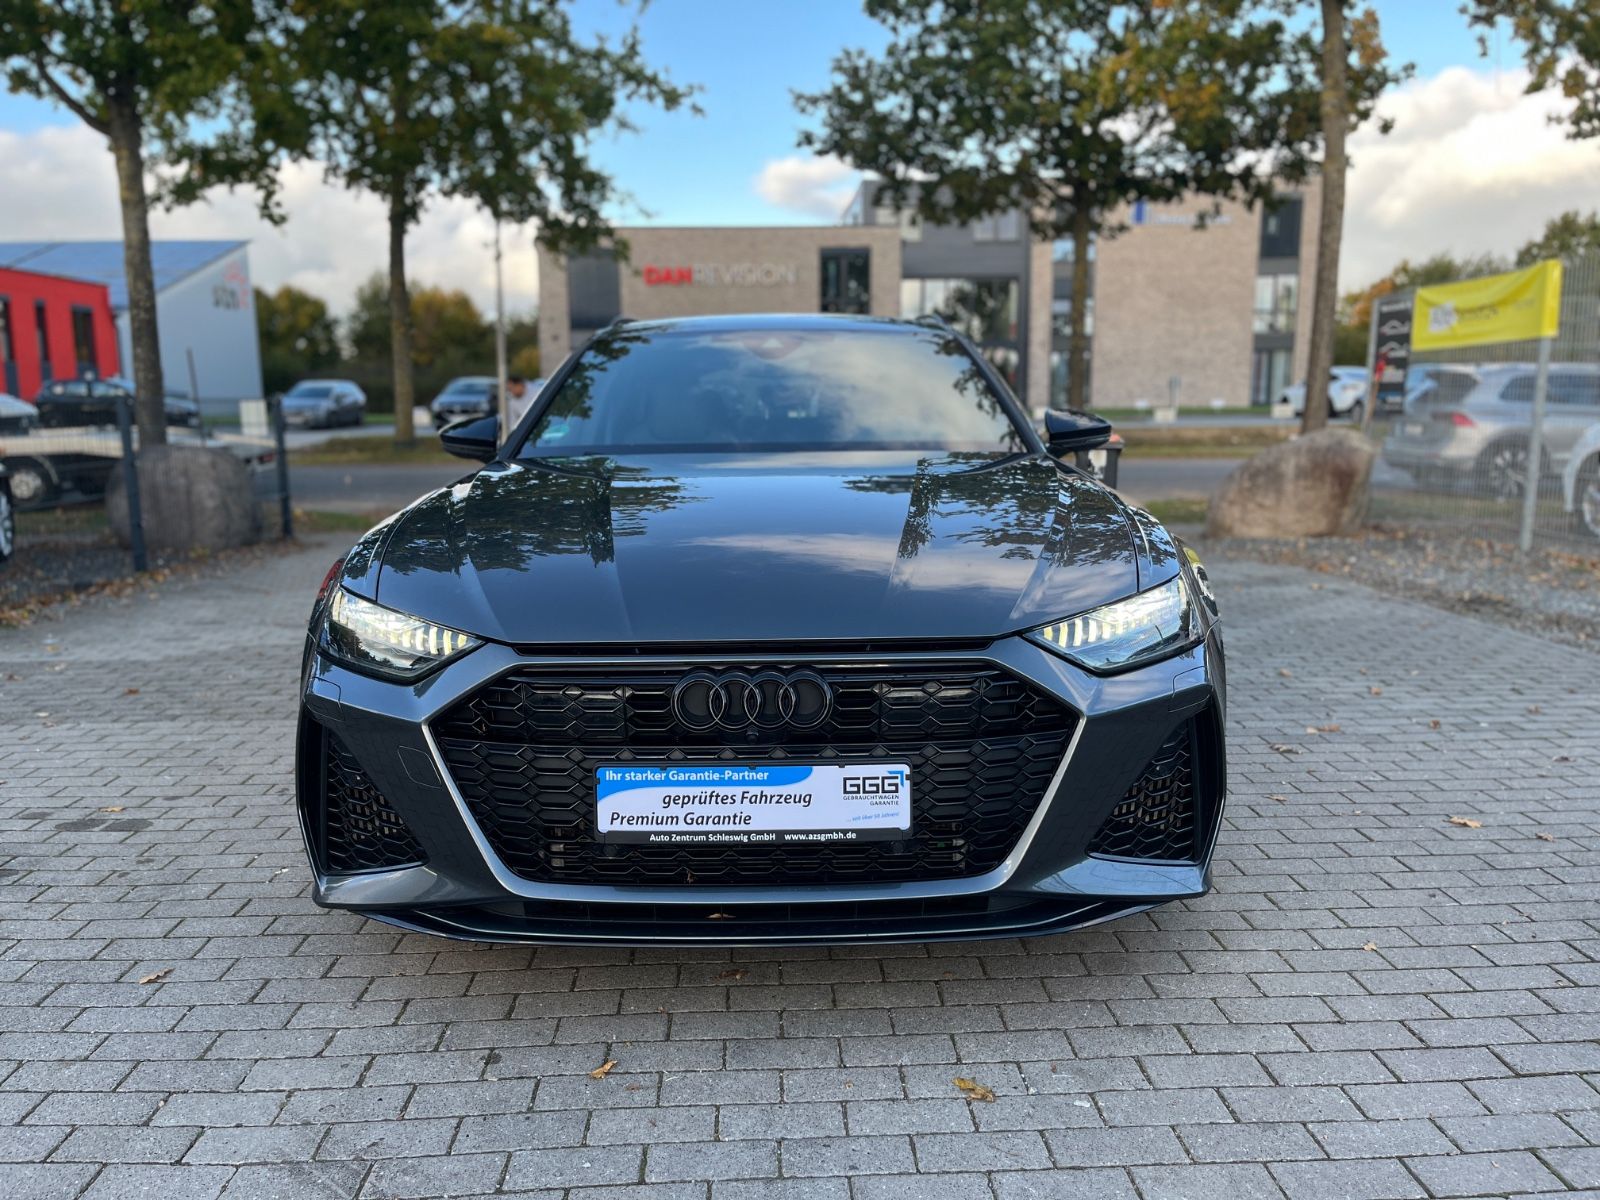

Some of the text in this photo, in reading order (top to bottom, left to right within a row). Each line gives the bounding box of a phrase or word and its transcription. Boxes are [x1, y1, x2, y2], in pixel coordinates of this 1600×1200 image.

[606, 770, 769, 781] Ihr starker Garantie-Partner
[843, 776, 899, 794] GGG
[662, 790, 812, 808] geprüftes Fahrzeug
[610, 811, 752, 826] Premium Garantie
[649, 831, 857, 842] Auto Zentrum Schleswig GmbH www.azsgmbh.de
